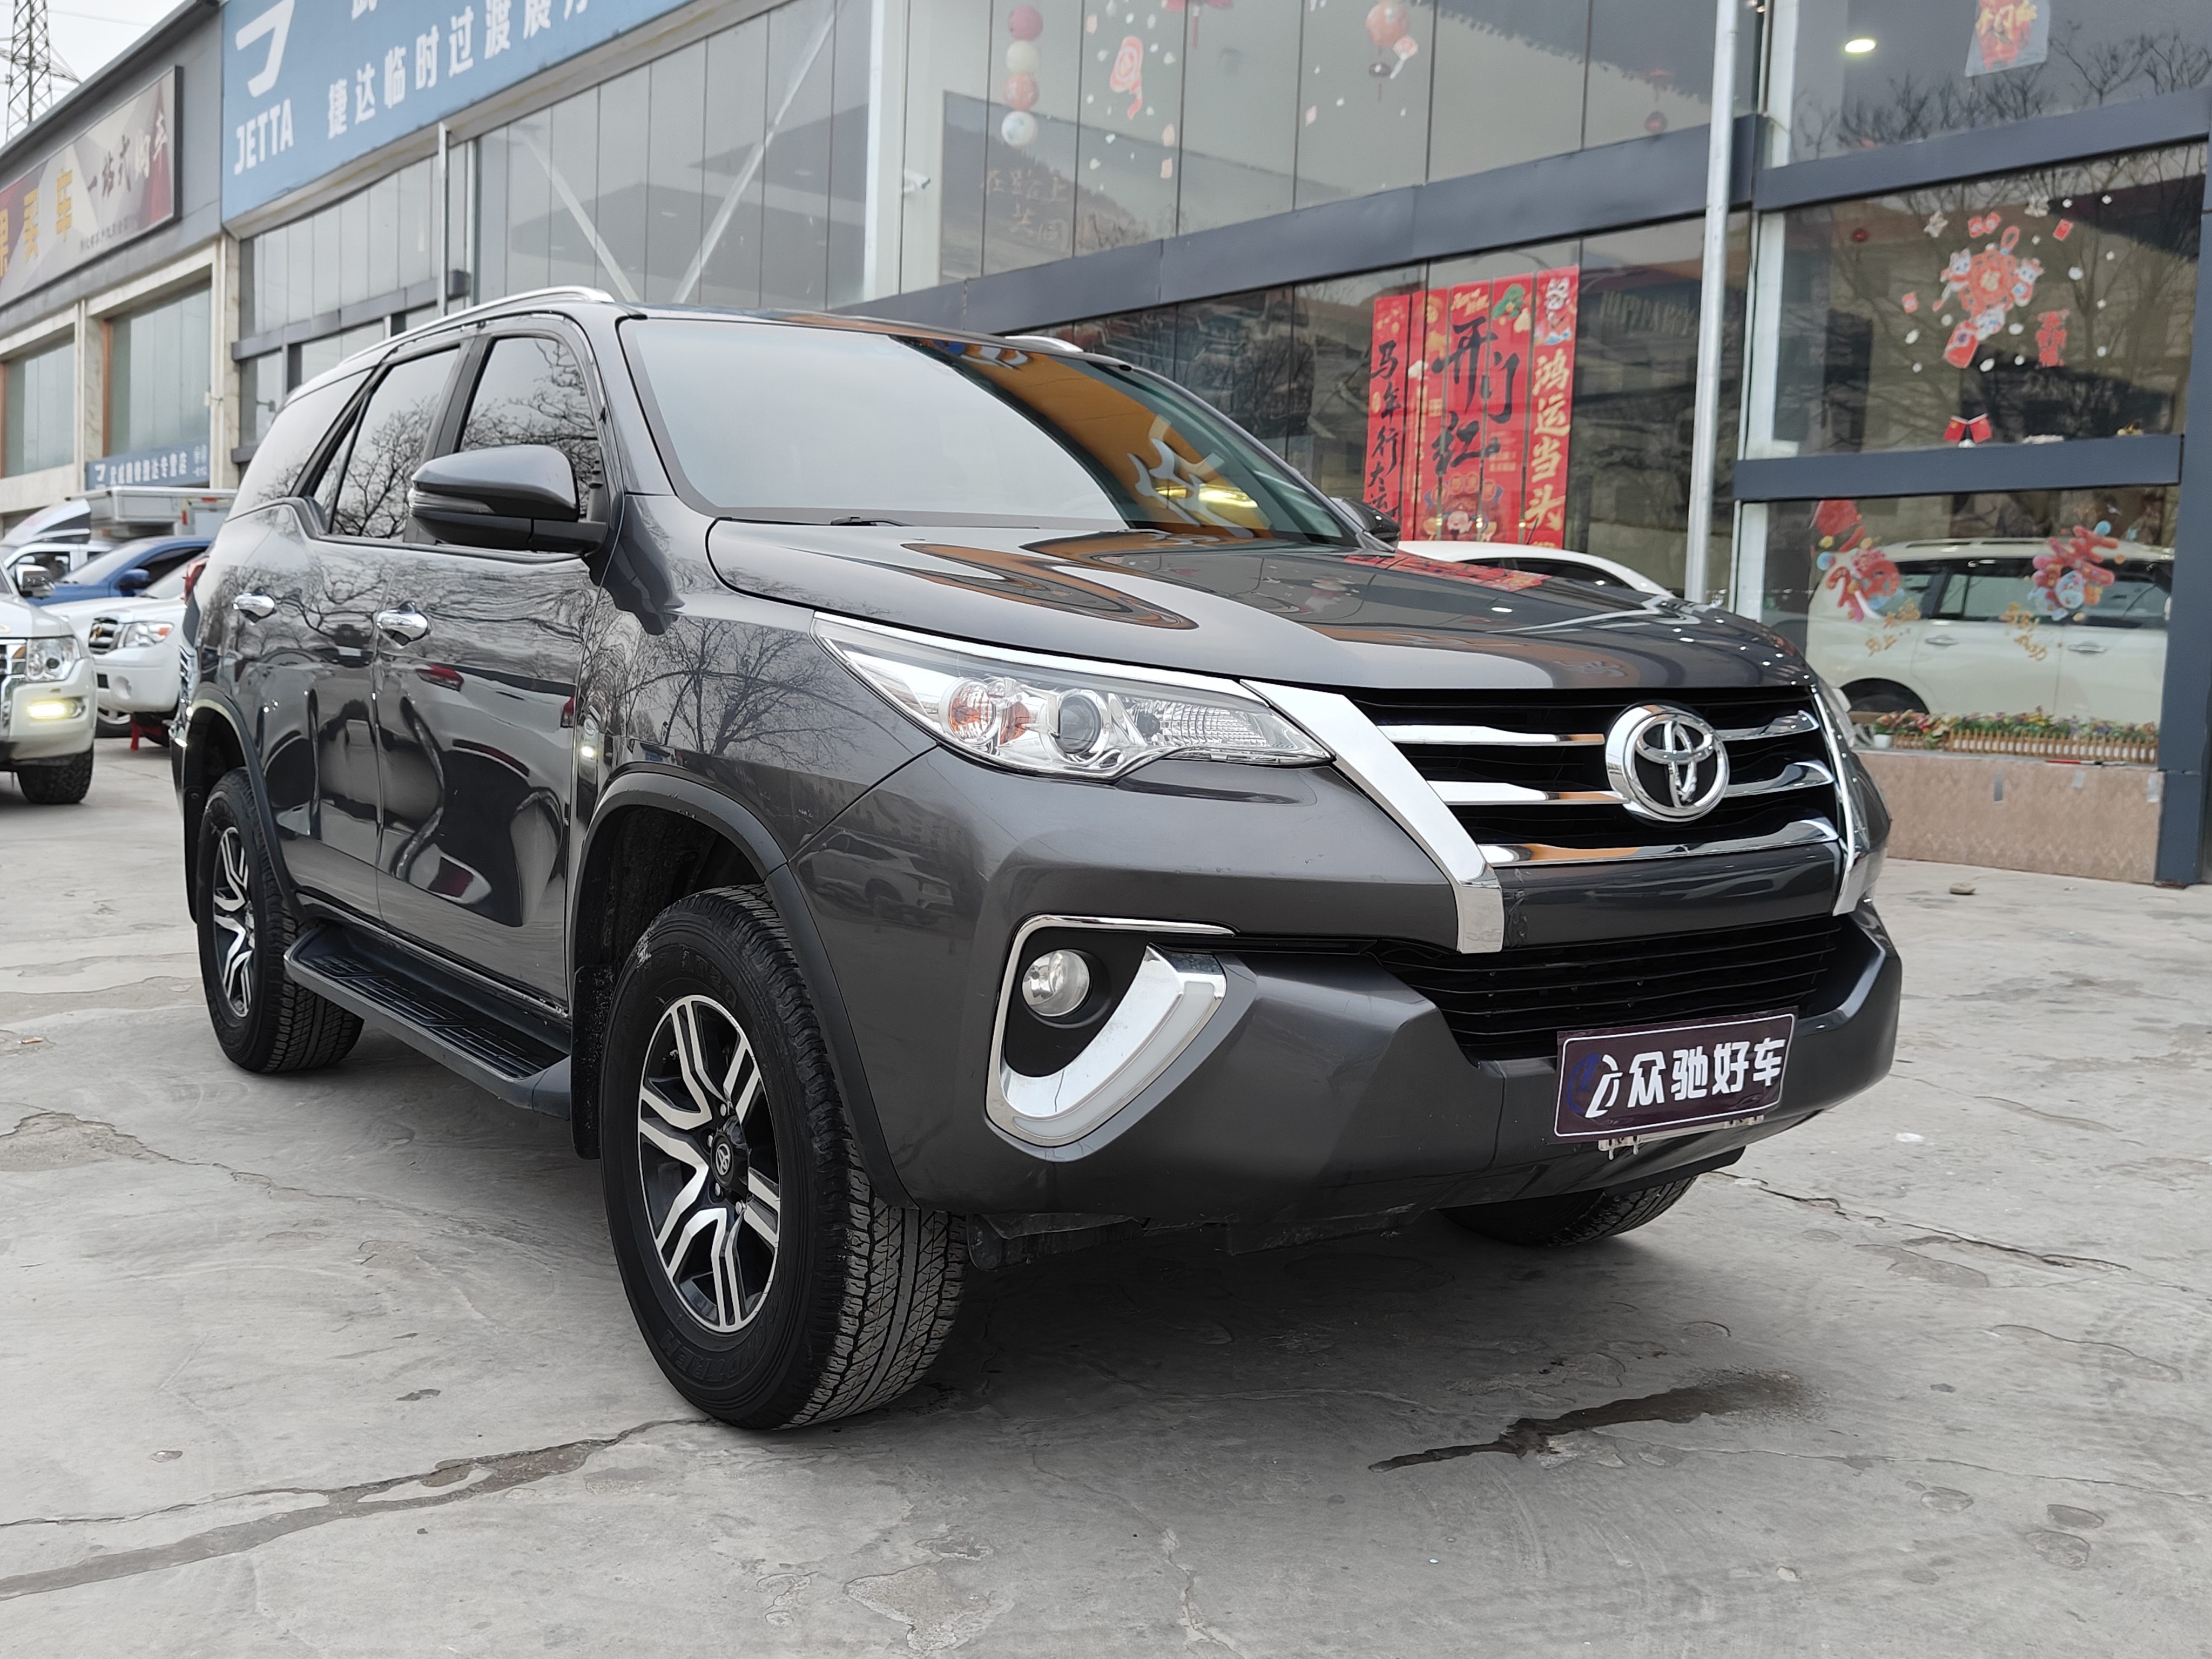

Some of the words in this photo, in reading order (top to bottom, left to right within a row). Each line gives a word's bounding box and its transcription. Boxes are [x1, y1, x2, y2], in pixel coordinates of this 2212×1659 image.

[234, 98, 294, 176] JETTA
[328, 0, 589, 139] 捷达临时过渡展
[1367, 339, 1402, 517] 马年行大运
[1431, 315, 1520, 477] 开门红
[1524, 347, 1570, 531] 鸿运当头
[1627, 1037, 1786, 1108] 众驰好车
